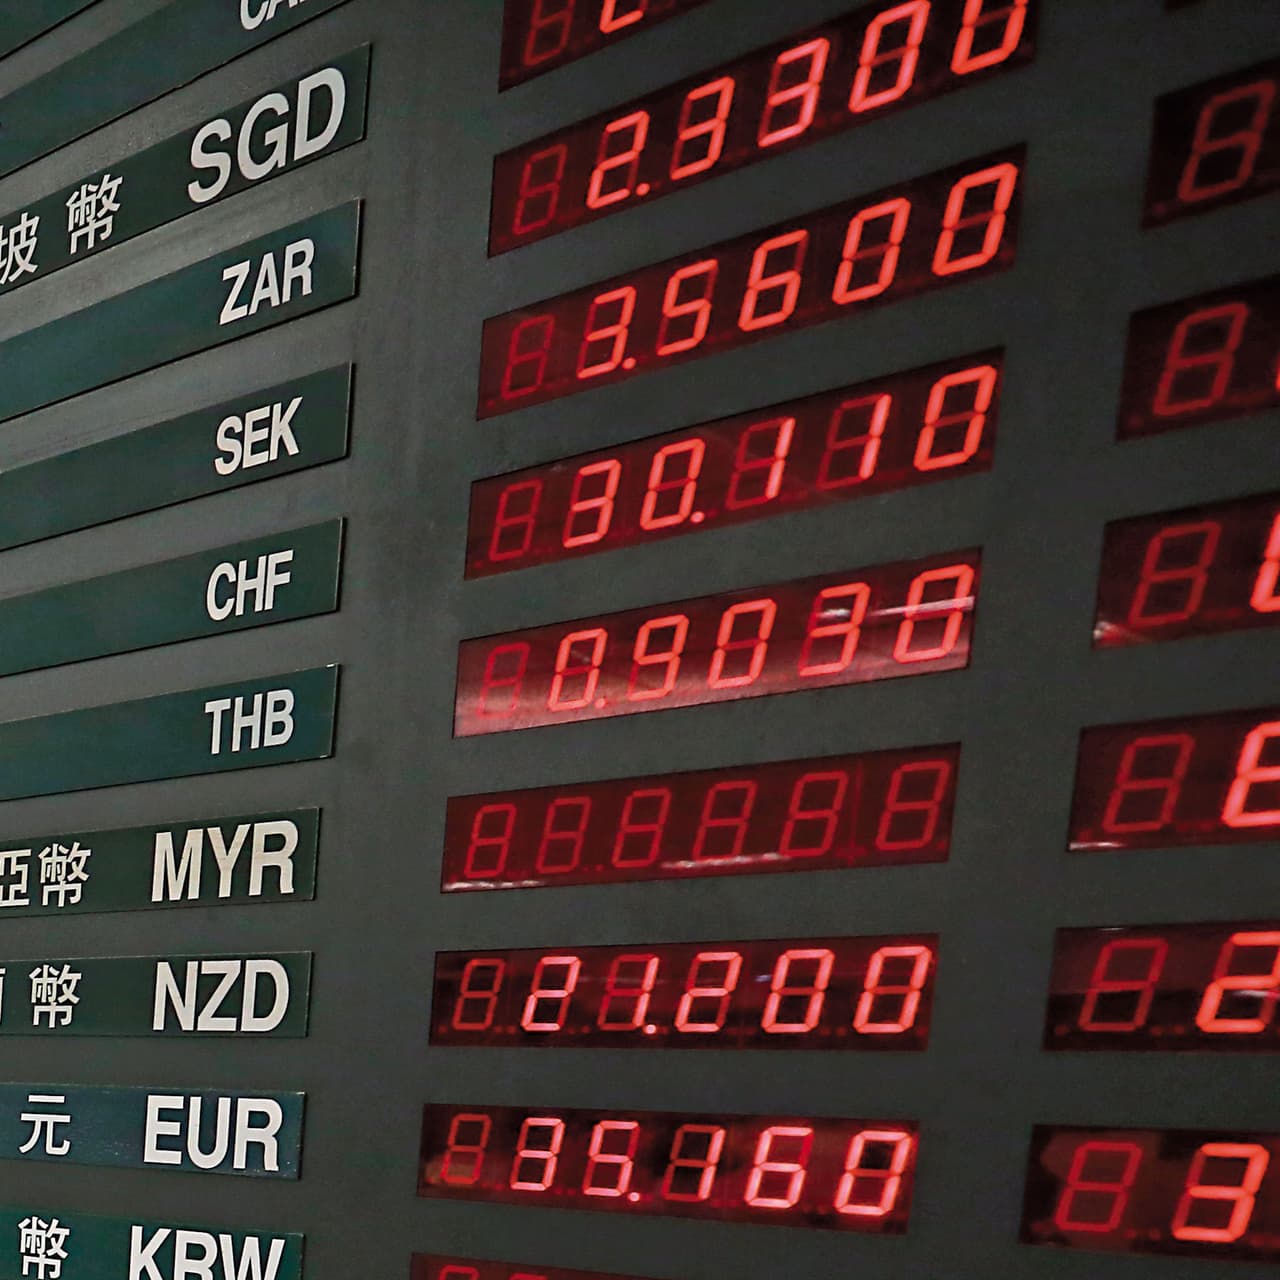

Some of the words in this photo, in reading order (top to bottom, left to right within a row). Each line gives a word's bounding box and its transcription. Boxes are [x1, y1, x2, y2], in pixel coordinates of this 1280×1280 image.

[188, 67, 346, 203] SGD
[219, 238, 315, 326] ZAR
[578, 163, 1017, 380] 3.5600
[214, 396, 303, 475] SEK
[564, 365, 996, 548] 30.110
[206, 549, 294, 621] CHF
[204, 689, 295, 755] THB
[151, 820, 299, 902] MYR
[152, 959, 290, 1032] NZD
[521, 946, 931, 1034] 21.200
[143, 1094, 283, 1172] EUR
[511, 1117, 913, 1217] 35.160
